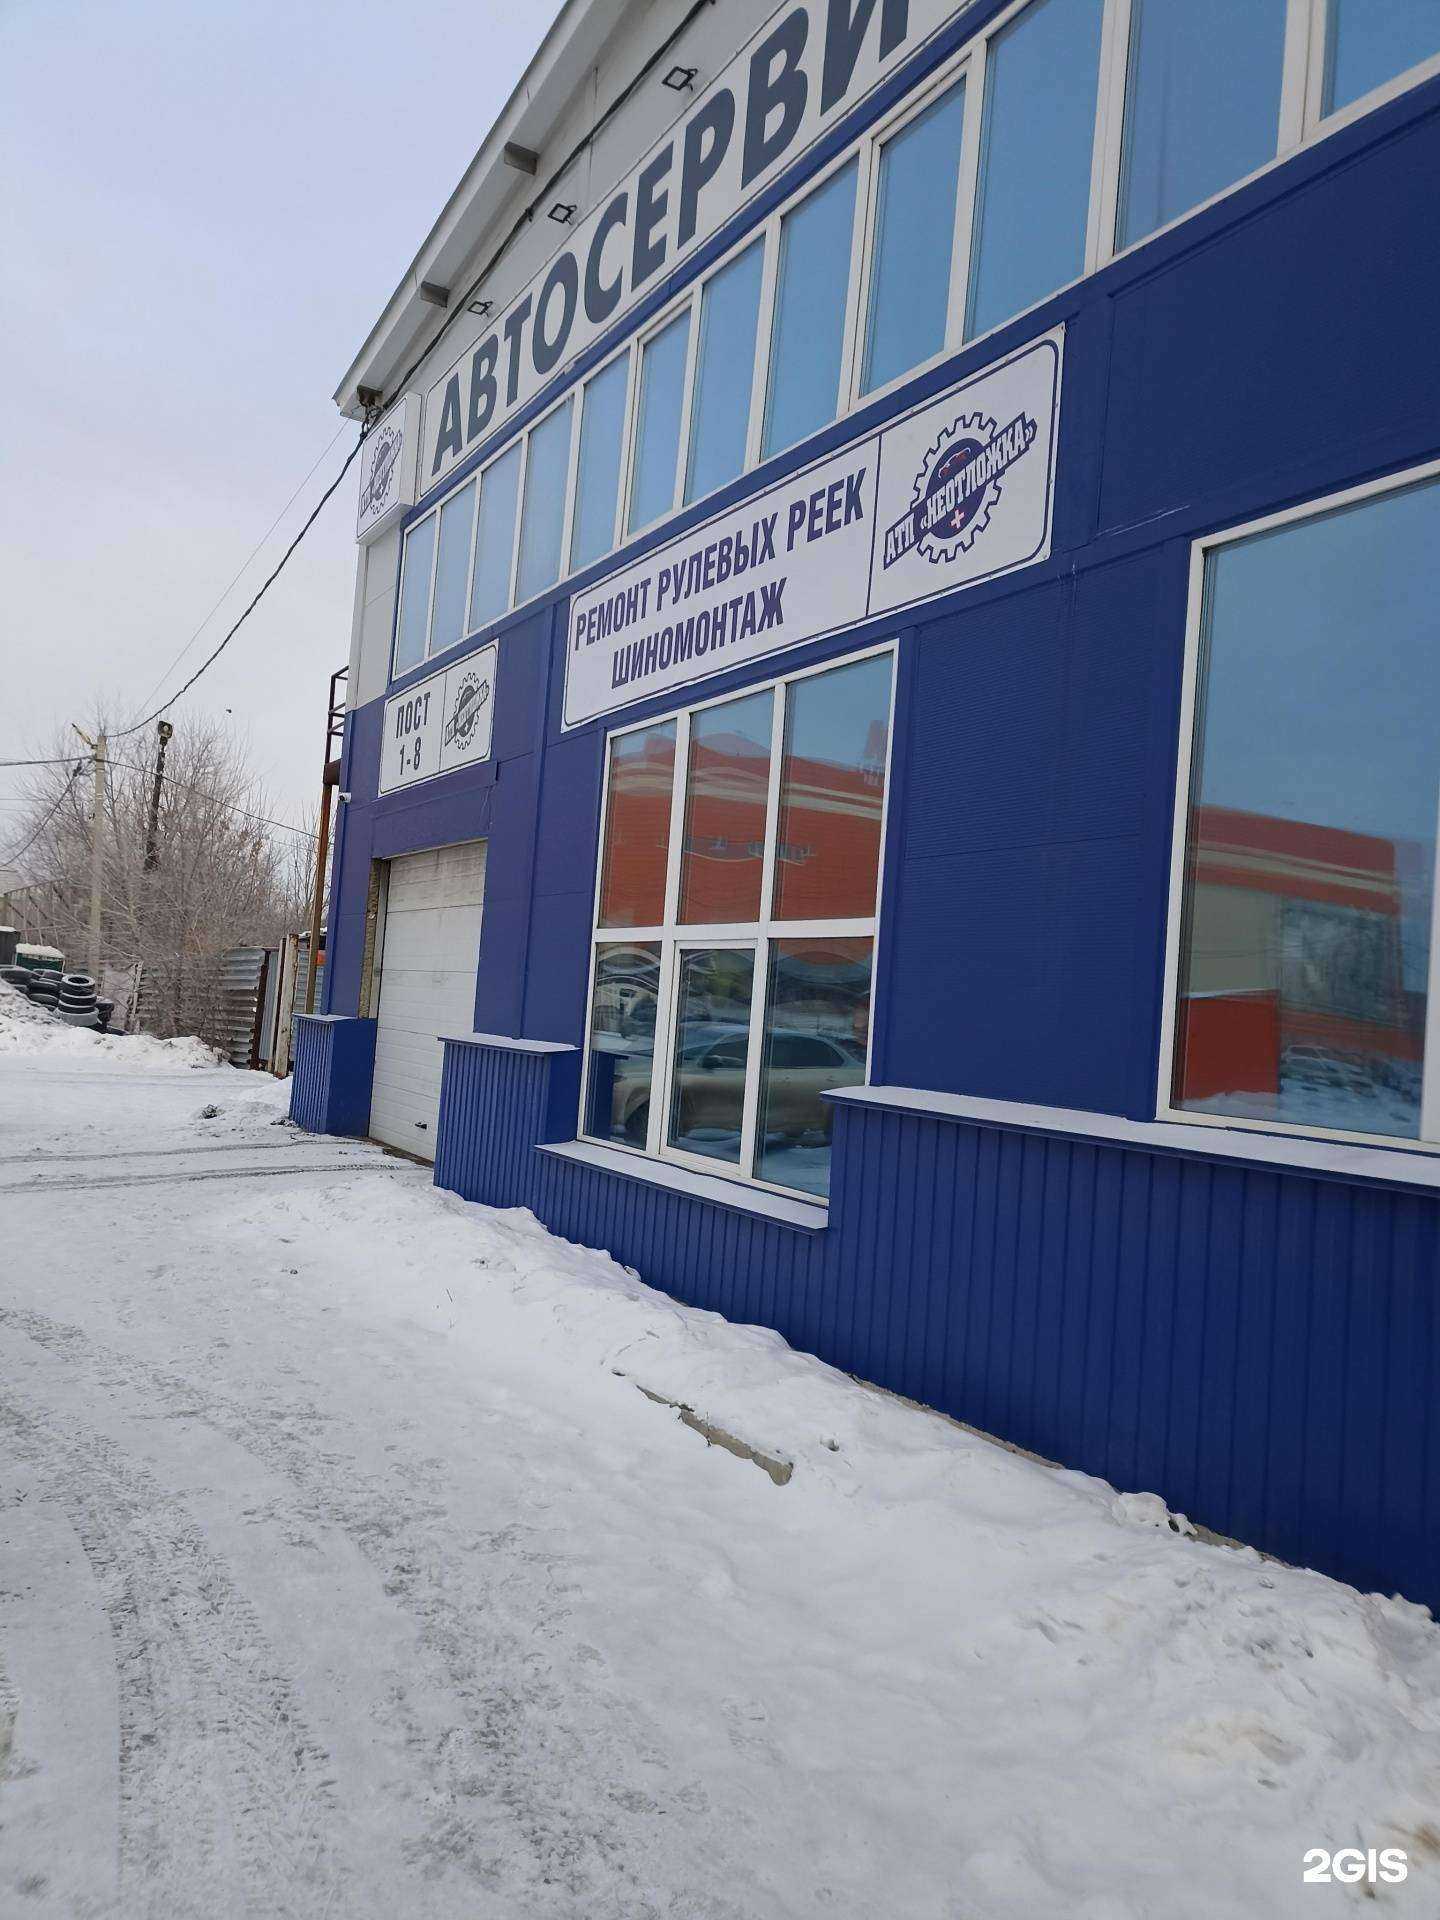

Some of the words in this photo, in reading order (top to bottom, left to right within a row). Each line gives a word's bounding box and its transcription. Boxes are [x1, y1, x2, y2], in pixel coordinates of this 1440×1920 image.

[575, 577, 651, 651] РЕМОНТ
[656, 511, 778, 612] РУЛЕВЫХ
[786, 467, 867, 552] РЕЕК
[884, 513, 916, 564] АТП
[611, 577, 787, 690] ШИНОМОНТАЖ
[396, 692, 431, 739] ПОСТ
[399, 736, 422, 776] 1-8
